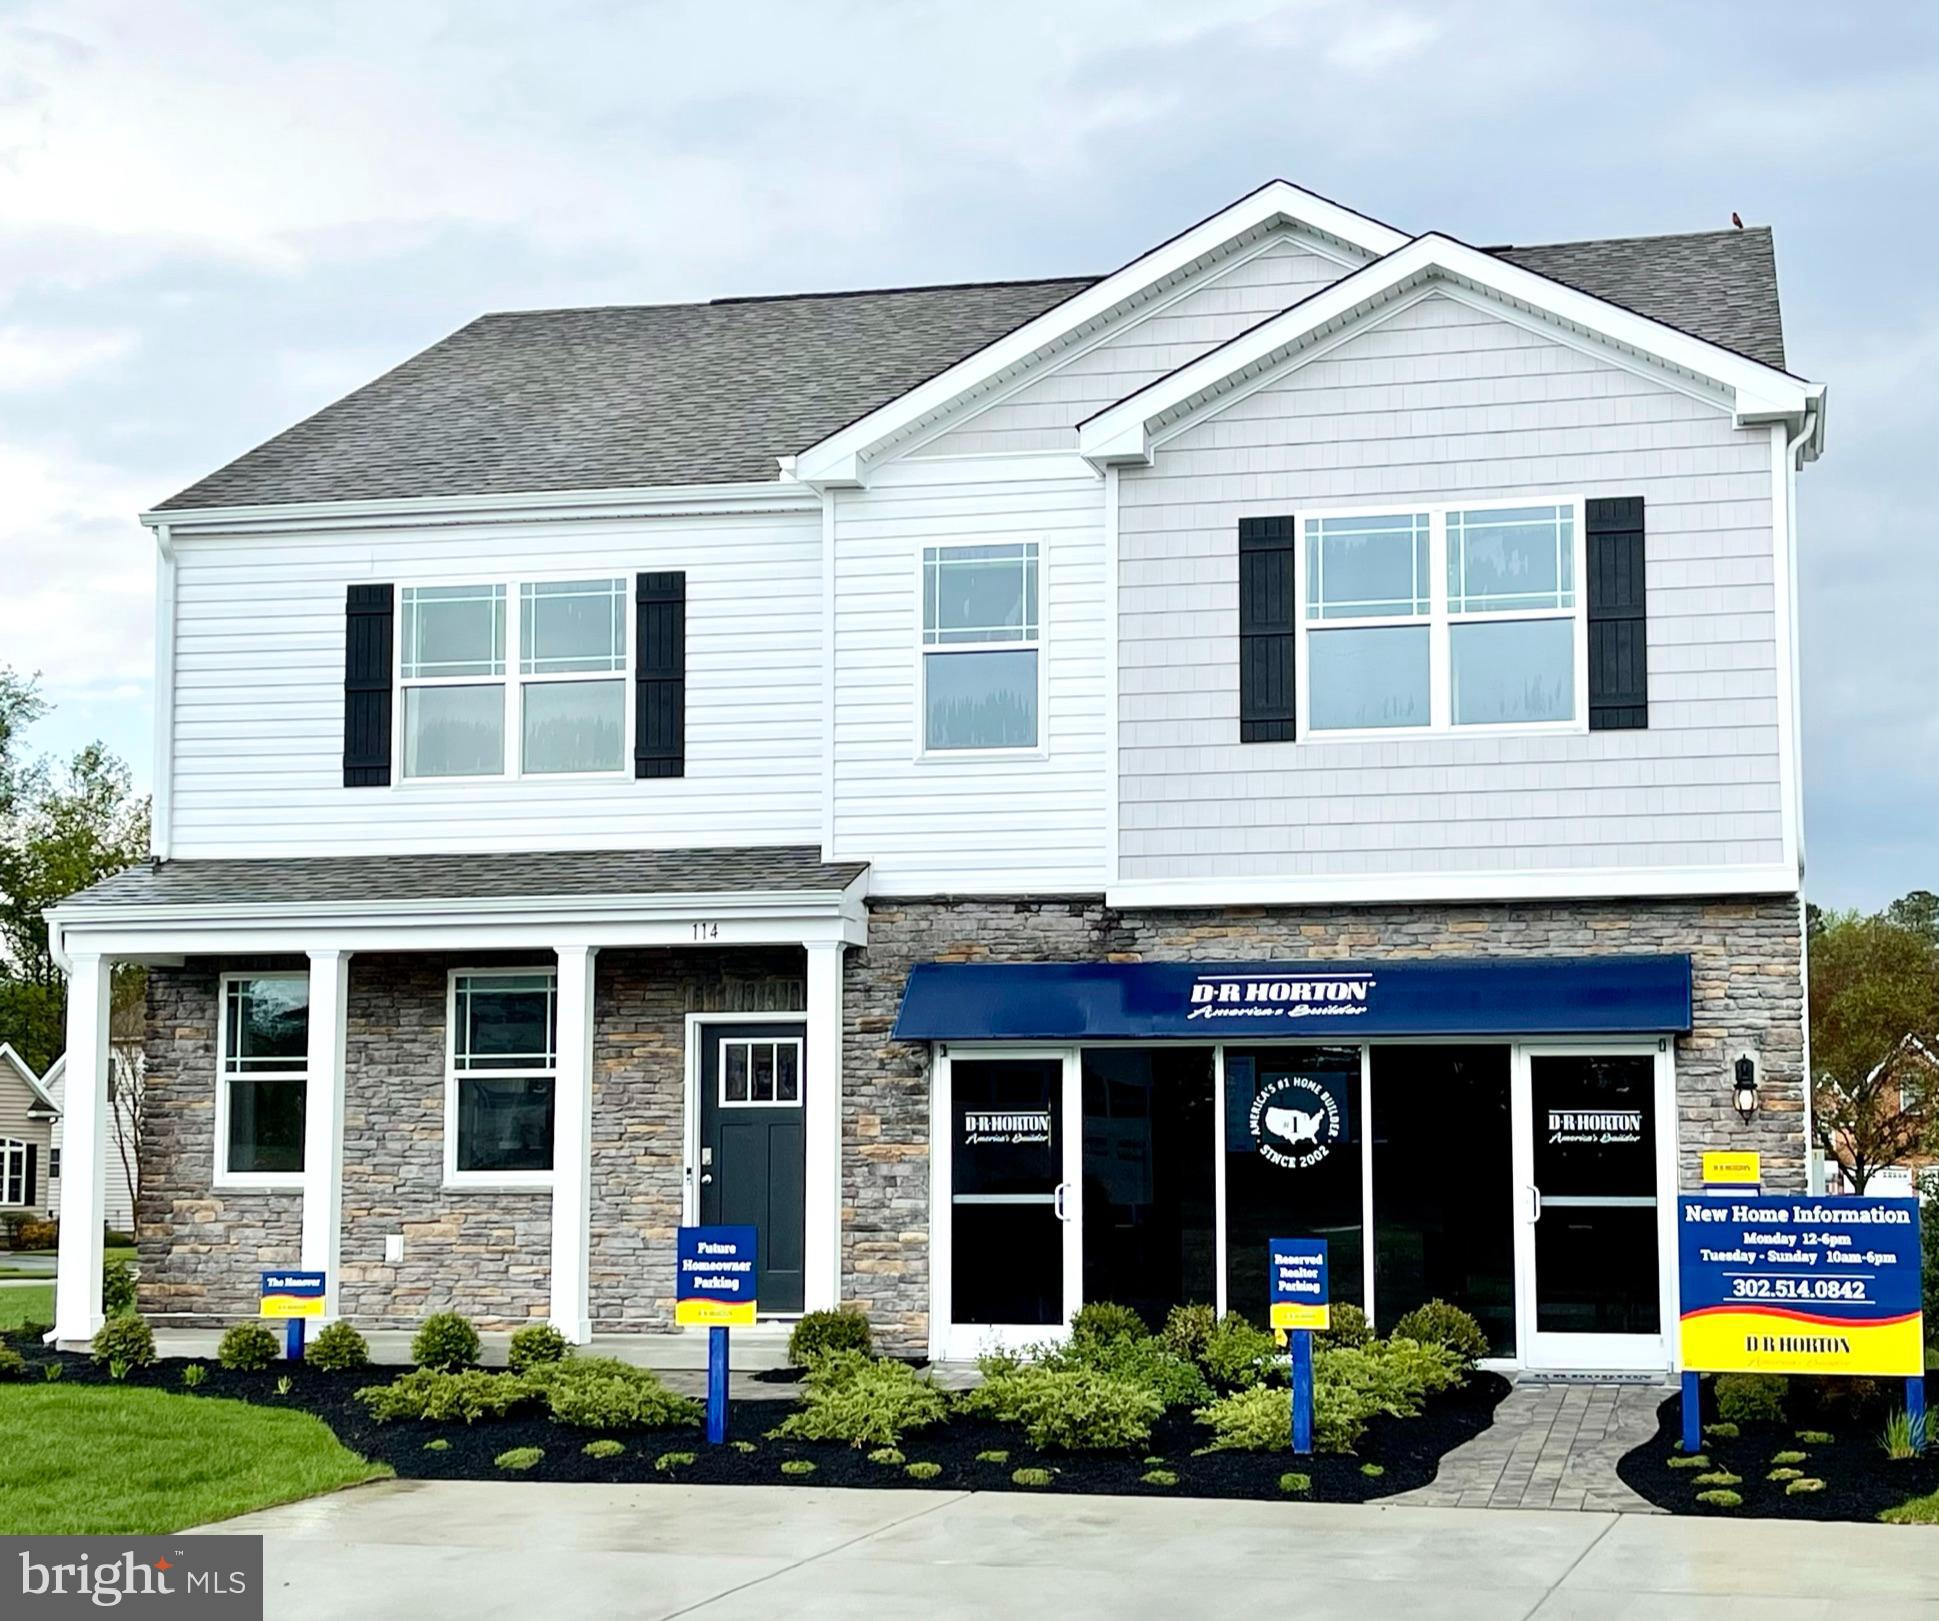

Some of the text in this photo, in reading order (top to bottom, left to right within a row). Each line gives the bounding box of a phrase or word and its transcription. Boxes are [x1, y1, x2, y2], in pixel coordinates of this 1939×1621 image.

[692, 922, 718, 940] 114
[1244, 981, 1369, 1002] HORTON
[1287, 1004, 1368, 1018] Builder
[1249, 1083, 1276, 1136] AMERICA'S
[1293, 1076, 1323, 1095] HOME
[1320, 1091, 1340, 1137] BUILDER
[1259, 1144, 1330, 1168] SINCE 2002
[1685, 1206, 1910, 1224] New Home Information
[697, 1242, 737, 1254] Future
[1743, 1232, 1852, 1248] Monday 12-6pm
[682, 1259, 752, 1271] Homeowner
[1274, 1253, 1323, 1265] Reserved
[1700, 1249, 1756, 1264] Tuesday
[1767, 1250, 1817, 1265] Sunday
[1826, 1251, 1897, 1266] 10am-6pm
[1280, 1267, 1318, 1278] Realtor
[267, 1277, 284, 1287] The
[693, 1276, 740, 1292] Parking
[1278, 1280, 1320, 1294] Parking
[1733, 1279, 1866, 1299] 302.514.0842
[1780, 1337, 1850, 1353] HORTON
